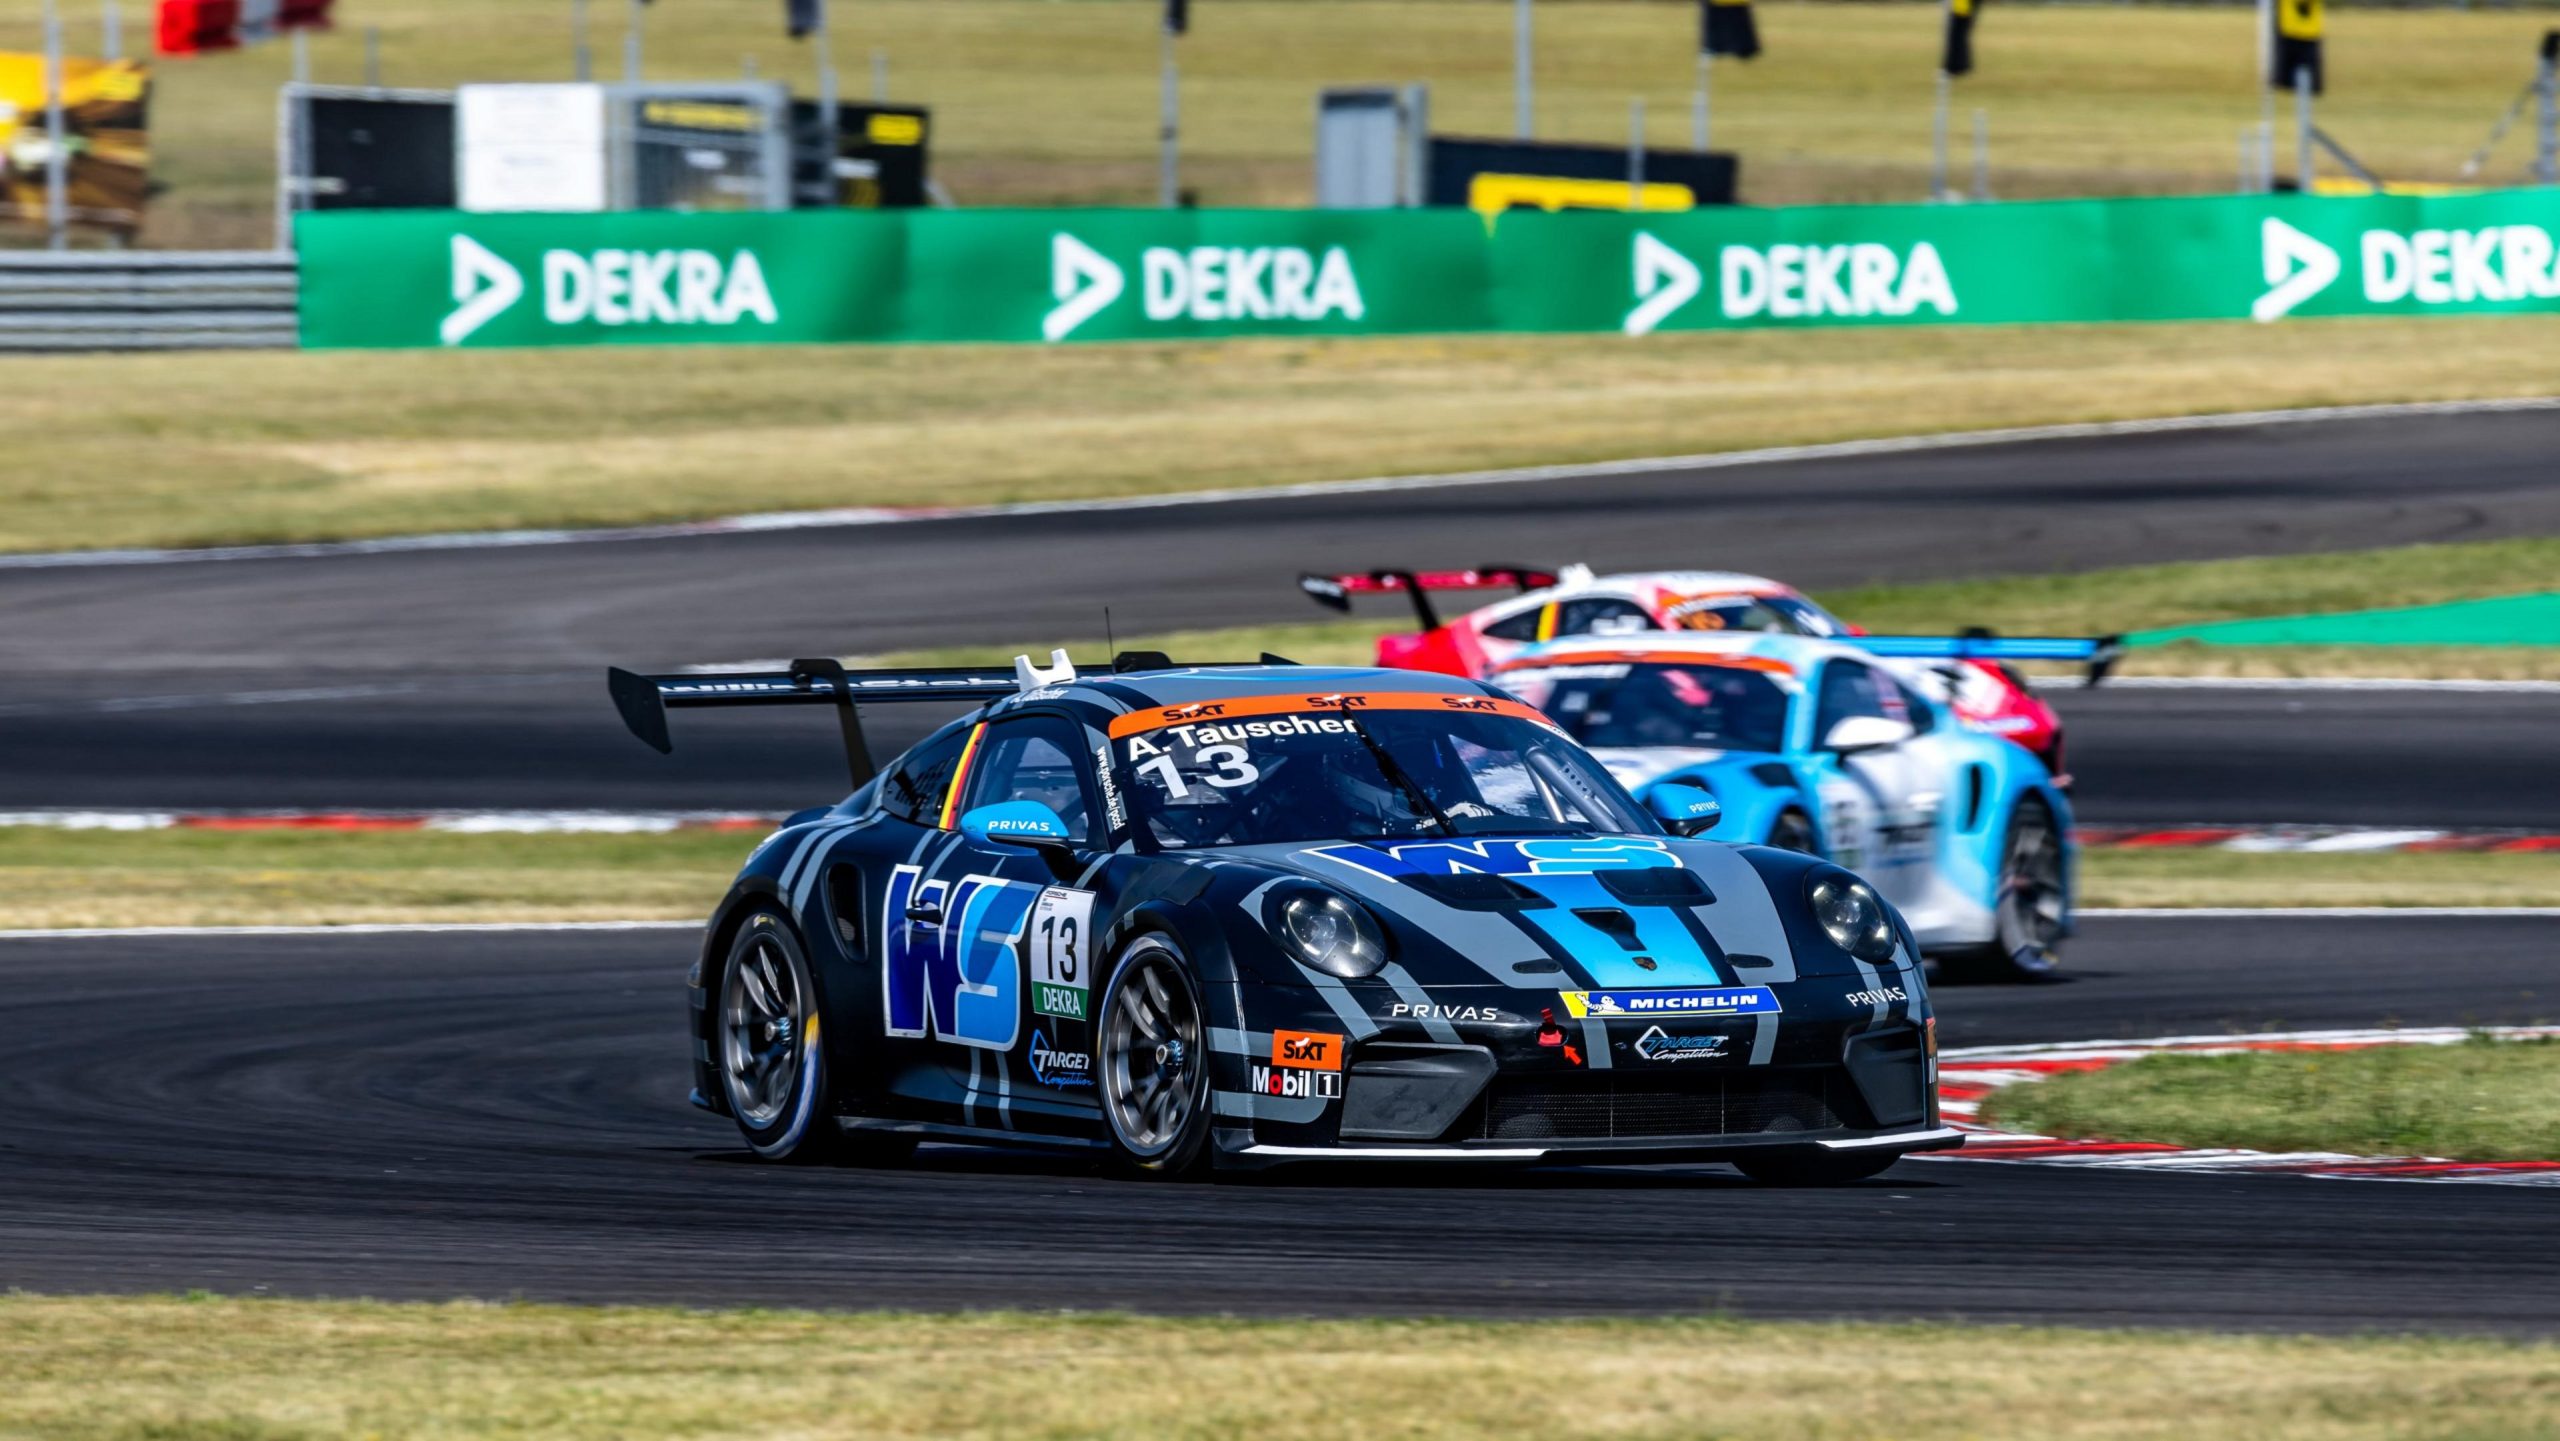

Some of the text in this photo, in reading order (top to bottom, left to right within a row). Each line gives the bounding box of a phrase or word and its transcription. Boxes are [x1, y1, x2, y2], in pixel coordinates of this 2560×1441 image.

[2361, 224, 2560, 303] DEKR
[543, 249, 777, 324] DEKRA
[1143, 246, 1365, 320] DEKRA
[1721, 242, 1958, 318] DEKRA
[1163, 704, 1225, 722] SIXT
[1306, 695, 1366, 708] SIXT
[1442, 696, 1498, 712] SIXT
[1127, 714, 1357, 760] A.Tauscher
[1136, 744, 1259, 800] 13
[1688, 800, 1720, 813] PRIVAS
[987, 820, 1050, 832] PRIVAS
[1299, 836, 1684, 884] WS
[882, 864, 1044, 1052] WS
[1041, 916, 1078, 983] 13
[1043, 986, 1082, 1016] DEKRA
[1629, 993, 1759, 1010] MICHELIN
[1846, 986, 1908, 1007] PRIVAS
[1391, 1003, 1498, 1021] PRIVAS
[1283, 1037, 1327, 1062] SIXT
[1644, 1036, 1729, 1053] TARGET
[1652, 1048, 1729, 1063] Competition
[1033, 1049, 1090, 1073] TARGET
[1252, 1065, 1310, 1098] Mobil
